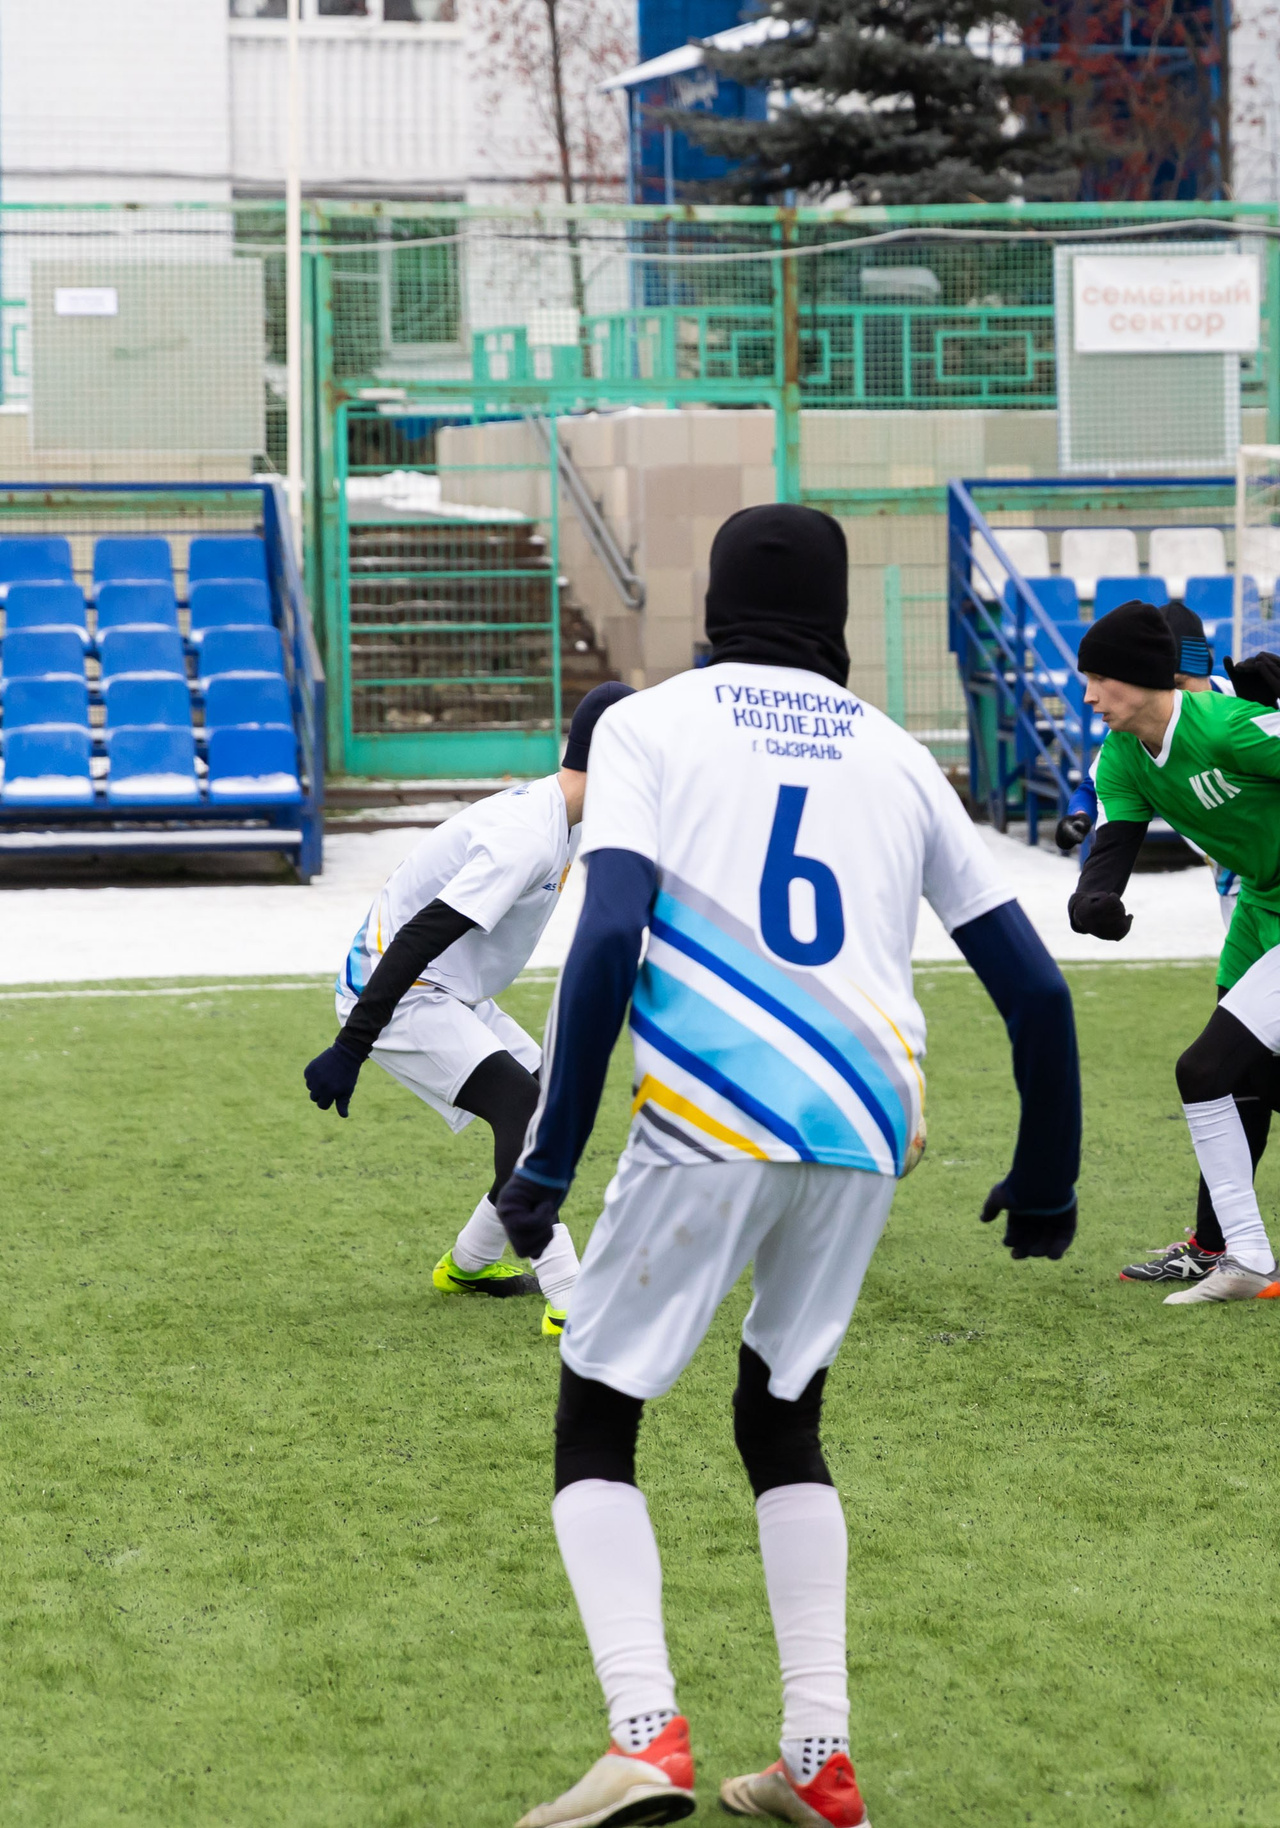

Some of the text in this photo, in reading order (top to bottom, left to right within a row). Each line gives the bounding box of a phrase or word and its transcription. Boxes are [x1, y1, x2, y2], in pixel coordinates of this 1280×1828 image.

[1109, 312, 1225, 337] сектор
[733, 707, 855, 738] КОЛЛЕДЖ
[766, 737, 842, 760] СЫЗРАНЬ
[759, 784, 845, 967] 6
